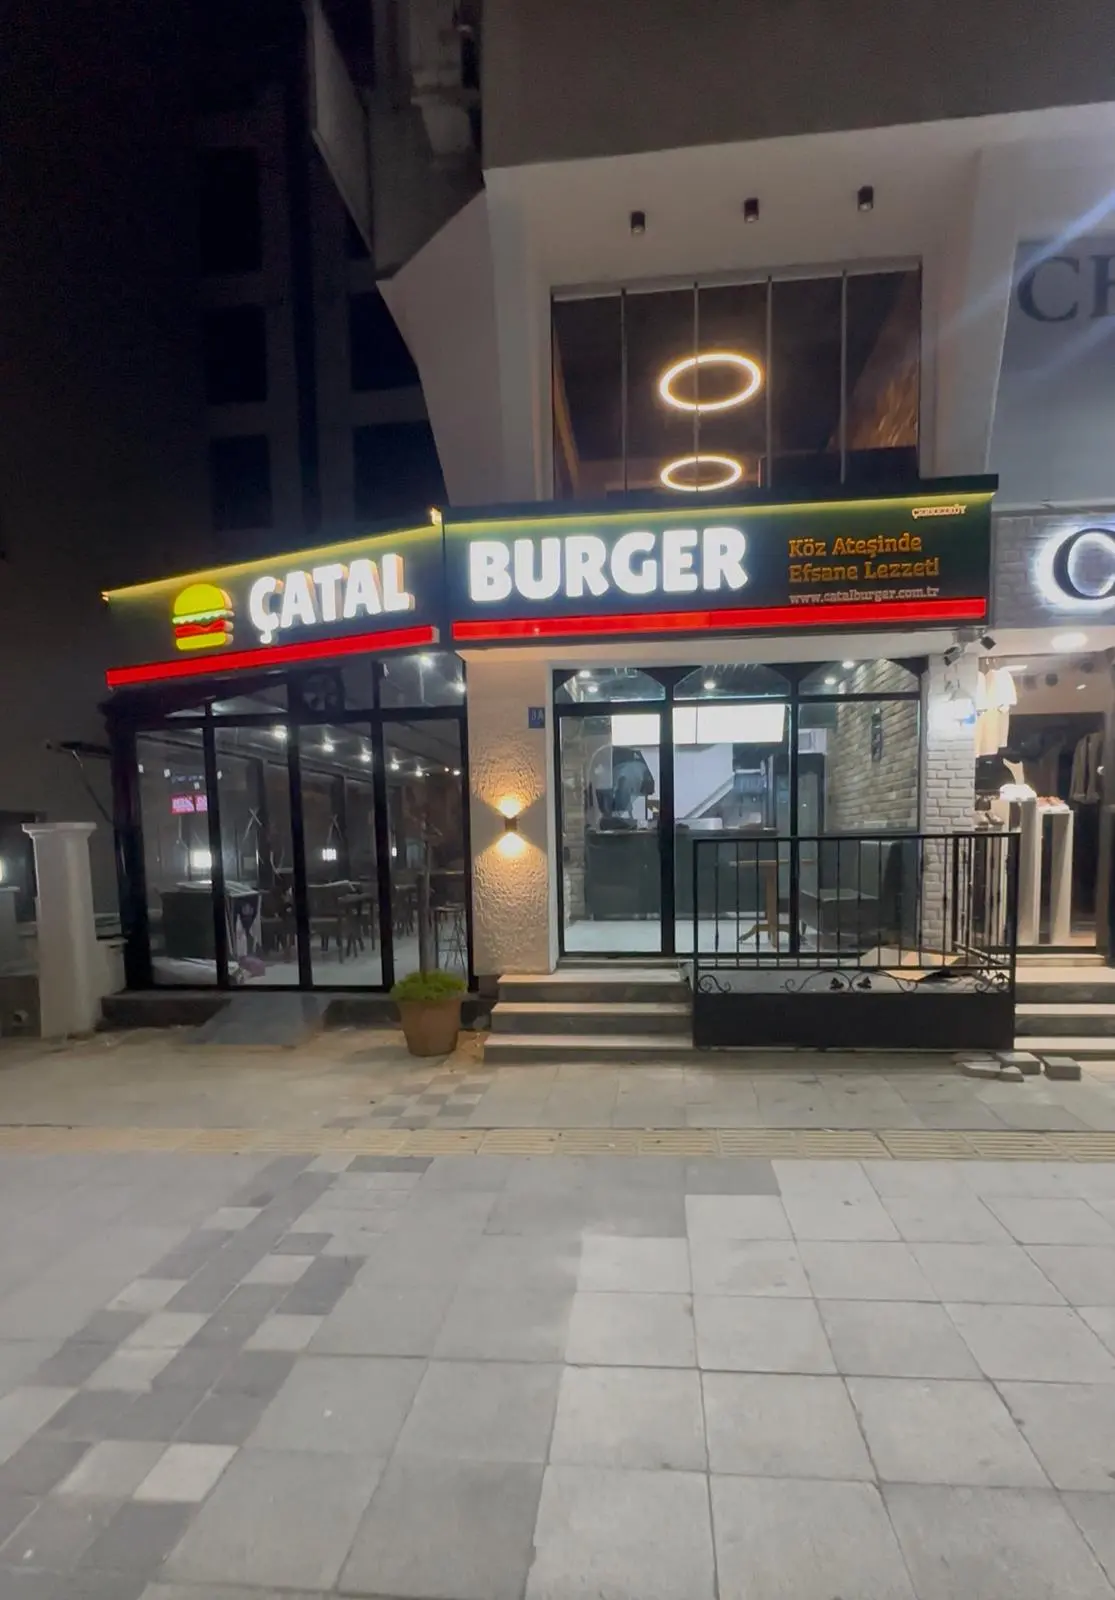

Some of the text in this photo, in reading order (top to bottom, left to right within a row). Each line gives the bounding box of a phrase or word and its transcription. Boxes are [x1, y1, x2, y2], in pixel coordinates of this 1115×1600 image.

[788, 532, 922, 558] Köz Ateşinde
[469, 527, 749, 602] BURGER
[788, 556, 940, 583] Efsane Lezzeti
[249, 553, 415, 644] ÇATAL
[788, 586, 940, 604] www.catalburger.com.tr
